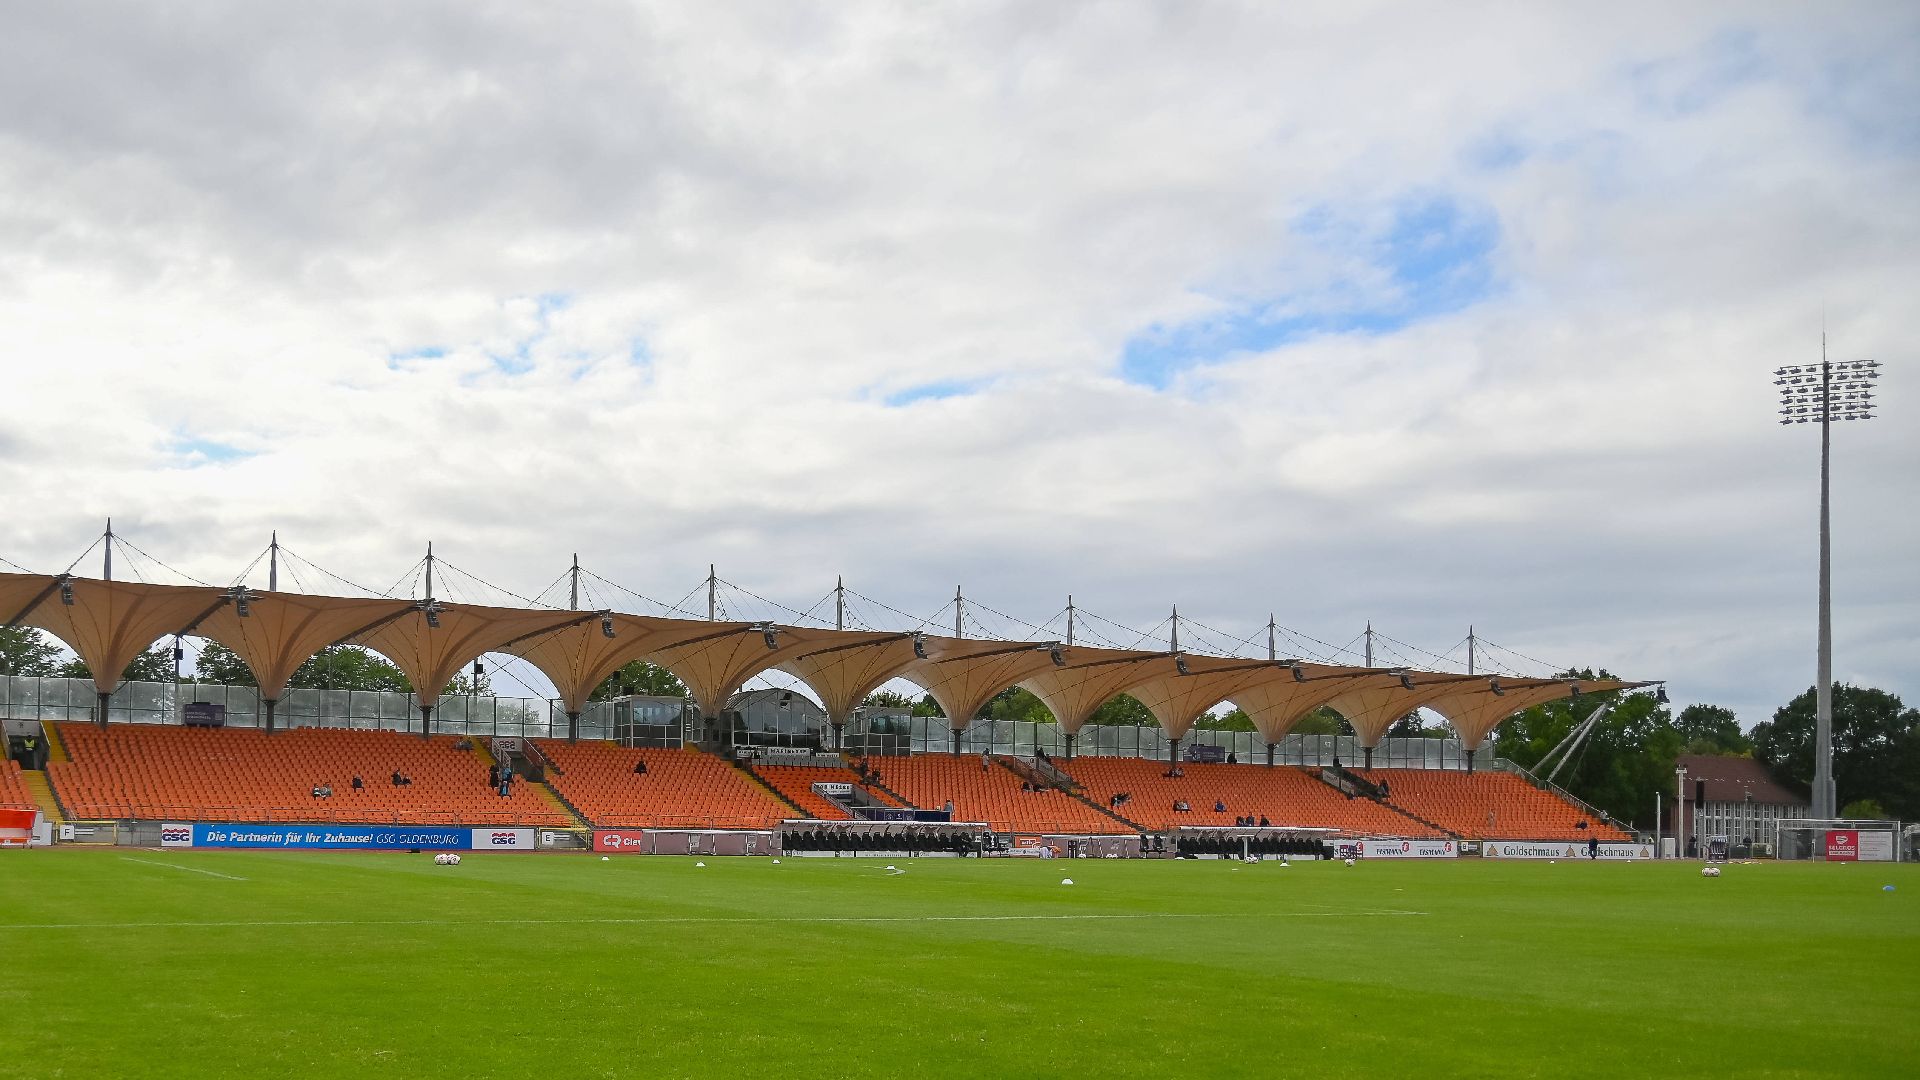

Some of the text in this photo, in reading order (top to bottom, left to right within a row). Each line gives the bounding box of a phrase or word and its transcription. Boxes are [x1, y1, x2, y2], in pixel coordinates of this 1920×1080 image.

[162, 833, 190, 841] GSG
[207, 831, 459, 846] Die Partnerin für Ihr Zuhause! GSG OLDENBURG
[491, 837, 516, 845] GSG
[545, 834, 551, 842] E
[1503, 845, 1560, 857] Goldschmaus
[1580, 846, 1634, 857] Gdschmaus
